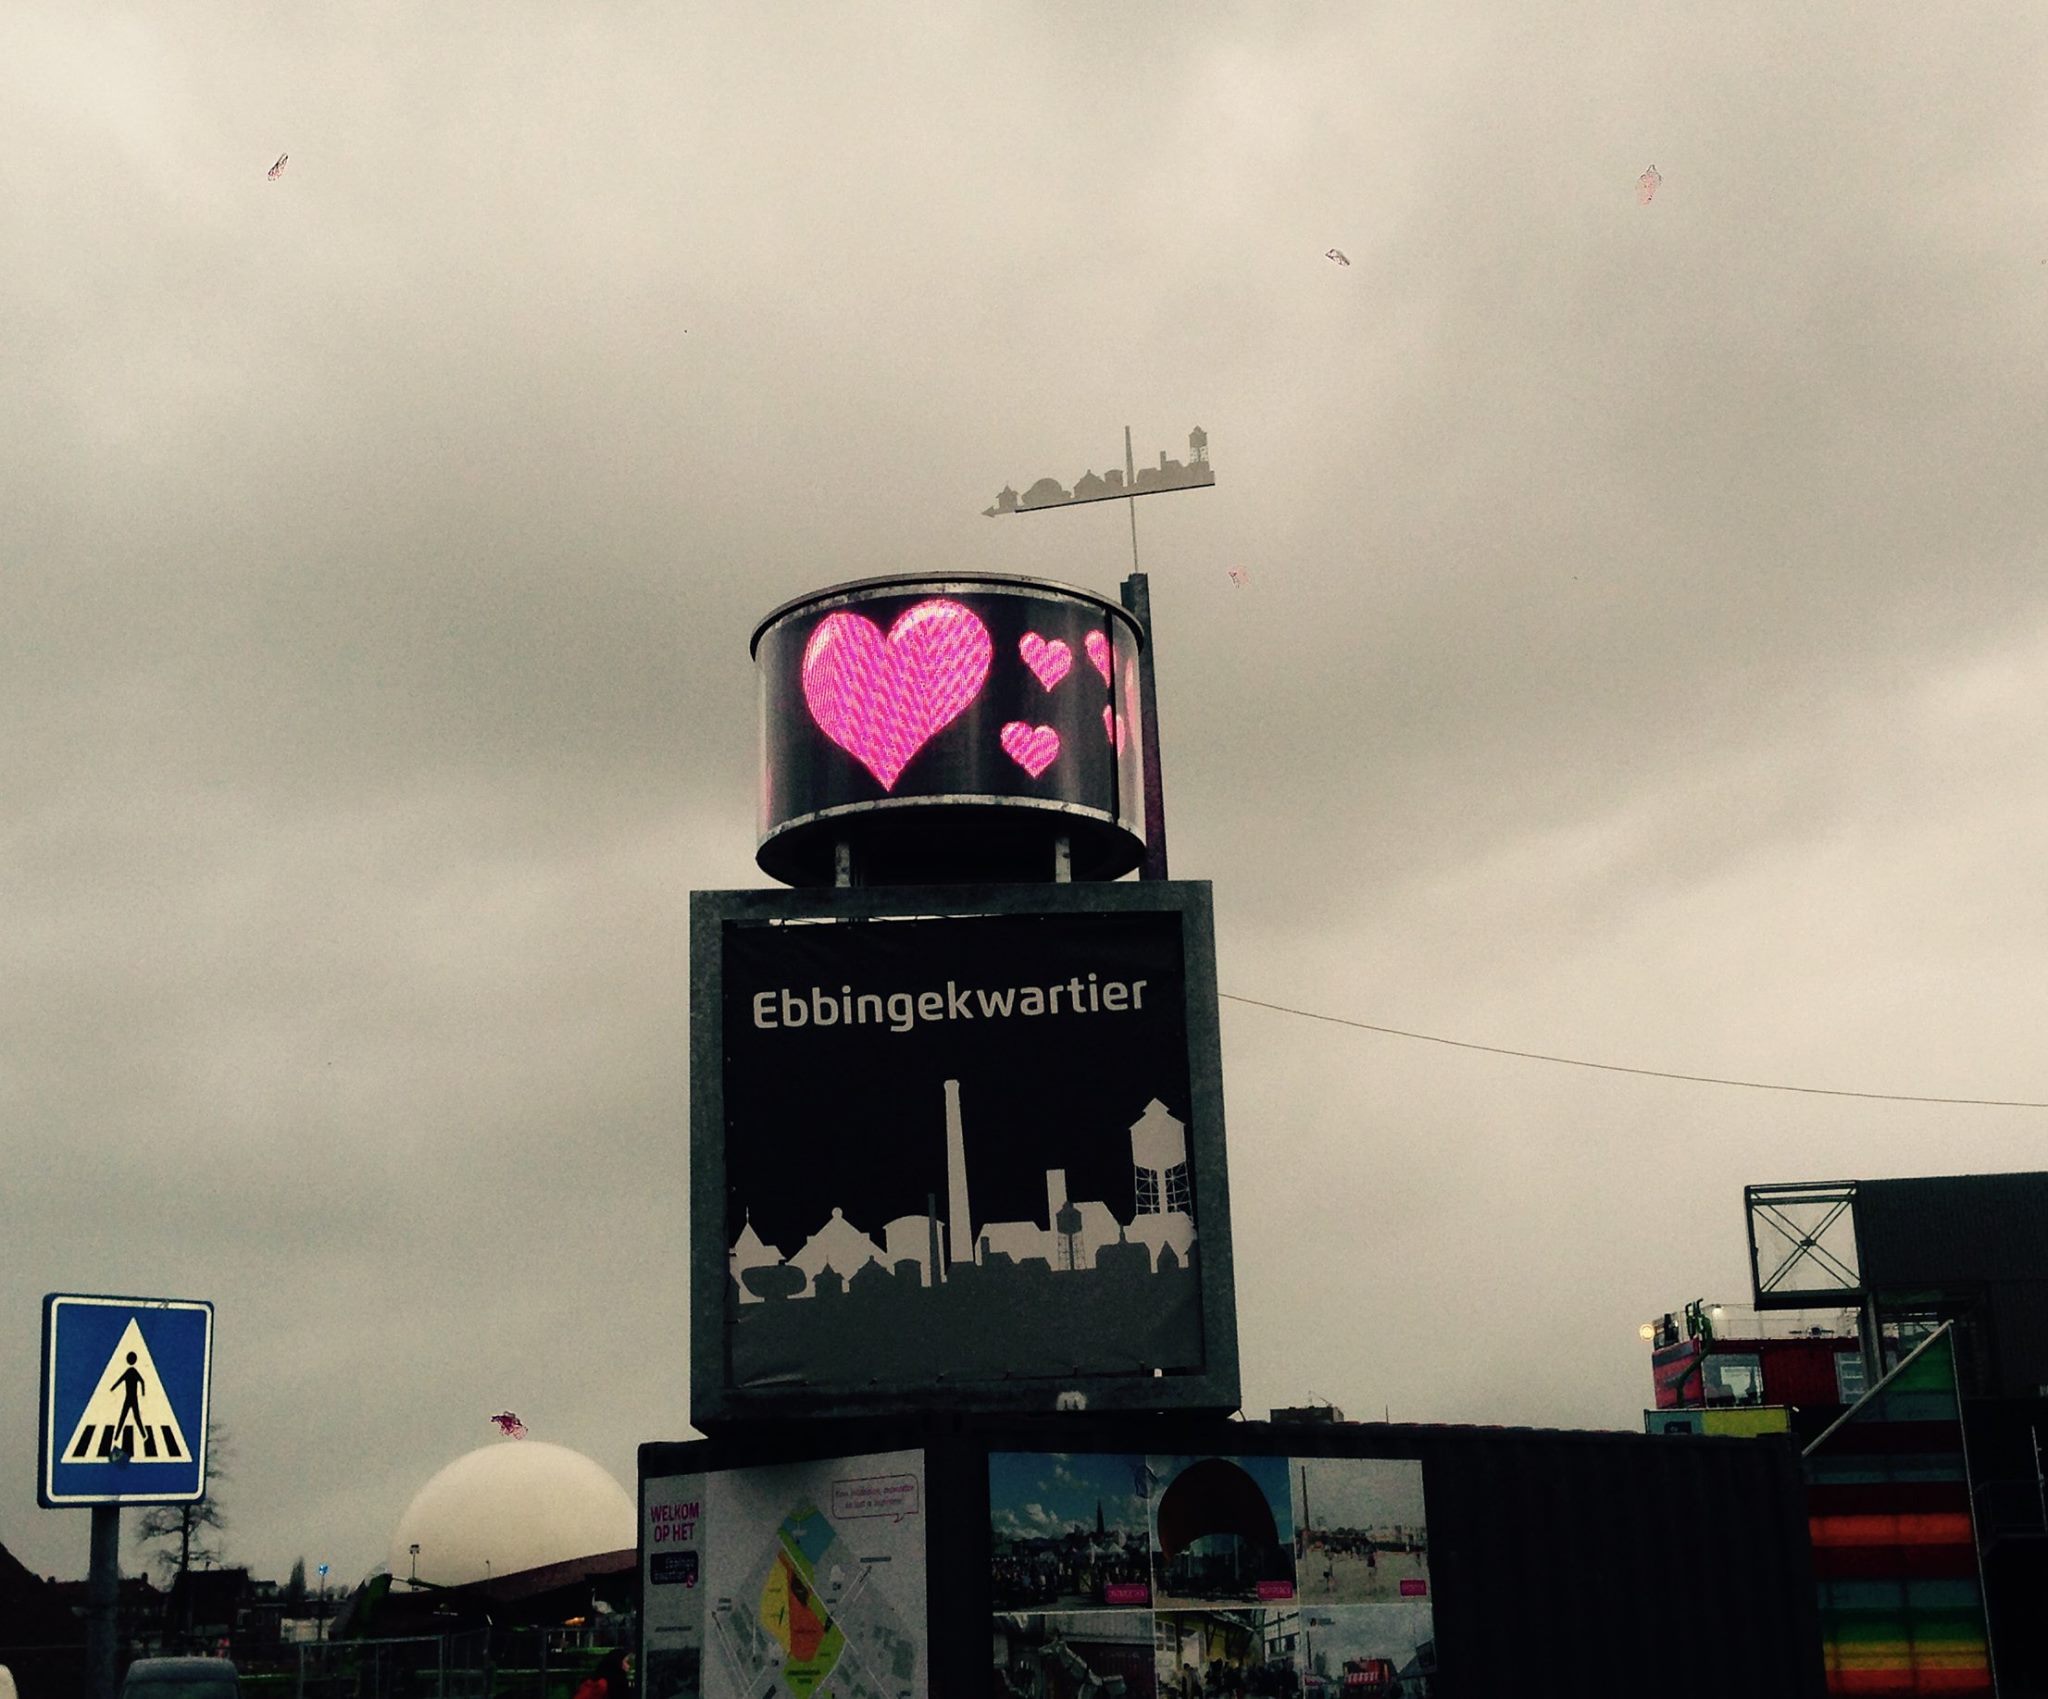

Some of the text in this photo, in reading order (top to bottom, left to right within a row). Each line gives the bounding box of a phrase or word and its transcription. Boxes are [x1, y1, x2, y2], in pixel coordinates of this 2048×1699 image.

[753, 972, 1148, 1033] Ebbingekwartier
[651, 1502, 700, 1523] WELKOM
[655, 1523, 695, 1543] OP HET
